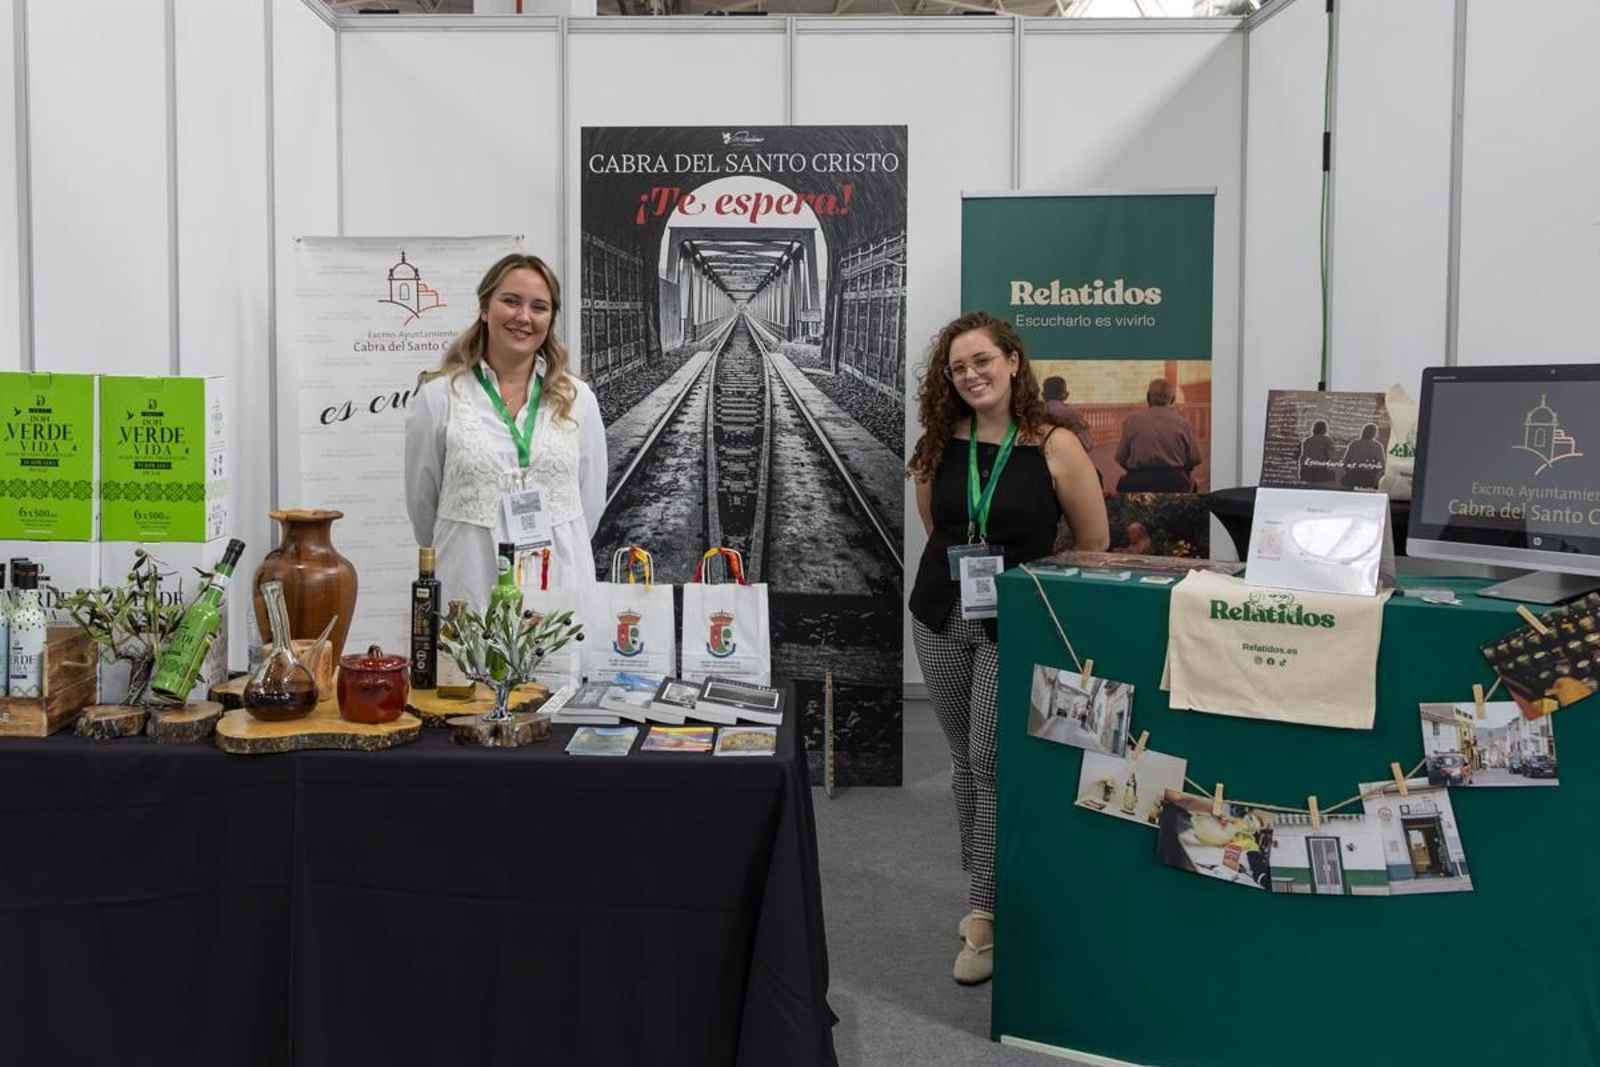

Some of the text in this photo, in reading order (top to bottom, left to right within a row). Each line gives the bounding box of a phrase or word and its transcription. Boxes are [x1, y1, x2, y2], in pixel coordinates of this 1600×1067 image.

[589, 152, 899, 173] CABRA DEL SANTO CRISTO
[636, 184, 854, 225] ¡Te espera!
[1009, 279, 1162, 306] Relatidos
[1015, 314, 1155, 327] Escucharlo es vivirlo
[353, 341, 385, 352] Cabra
[388, 341, 404, 351] del
[407, 342, 439, 352] Santo
[7, 423, 74, 440] VERDE
[120, 427, 186, 444] VERDE
[20, 441, 59, 452] VIDA
[134, 444, 171, 455] VIDA
[1448, 499, 1495, 518] Cabra
[1500, 502, 1526, 519] del
[1531, 505, 1583, 524] Santo
[1210, 599, 1335, 629] Relatidos
[1242, 642, 1298, 655] Relatidos.es
